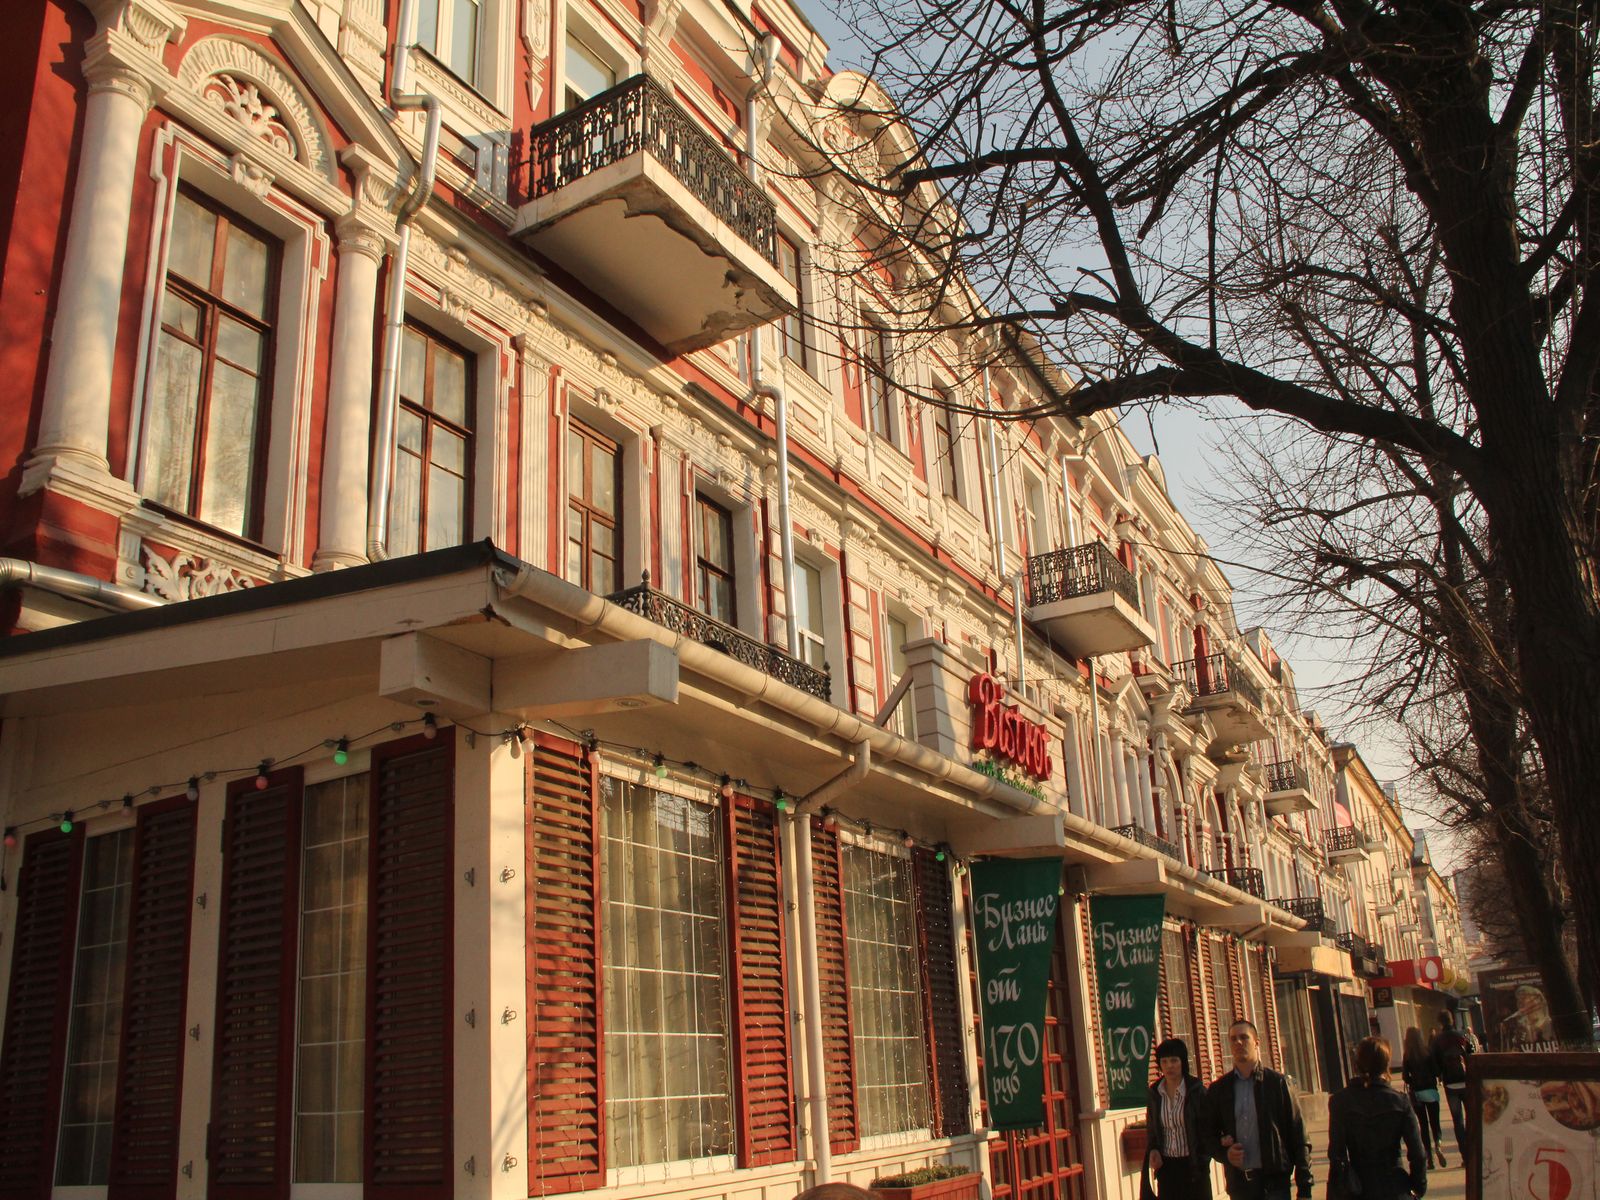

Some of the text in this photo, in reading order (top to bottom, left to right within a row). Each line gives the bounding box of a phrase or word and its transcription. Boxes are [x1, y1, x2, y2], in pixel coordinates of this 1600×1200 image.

[975, 893, 1055, 929] Бизнес
[1094, 921, 1160, 951] Бизнес
[987, 963, 1020, 1005] от
[1105, 981, 1134, 1011] от
[990, 1022, 1039, 1069] 170
[1107, 1025, 1149, 1062] 170
[993, 1063, 1020, 1106] руб
[1110, 1057, 1131, 1090] руб
